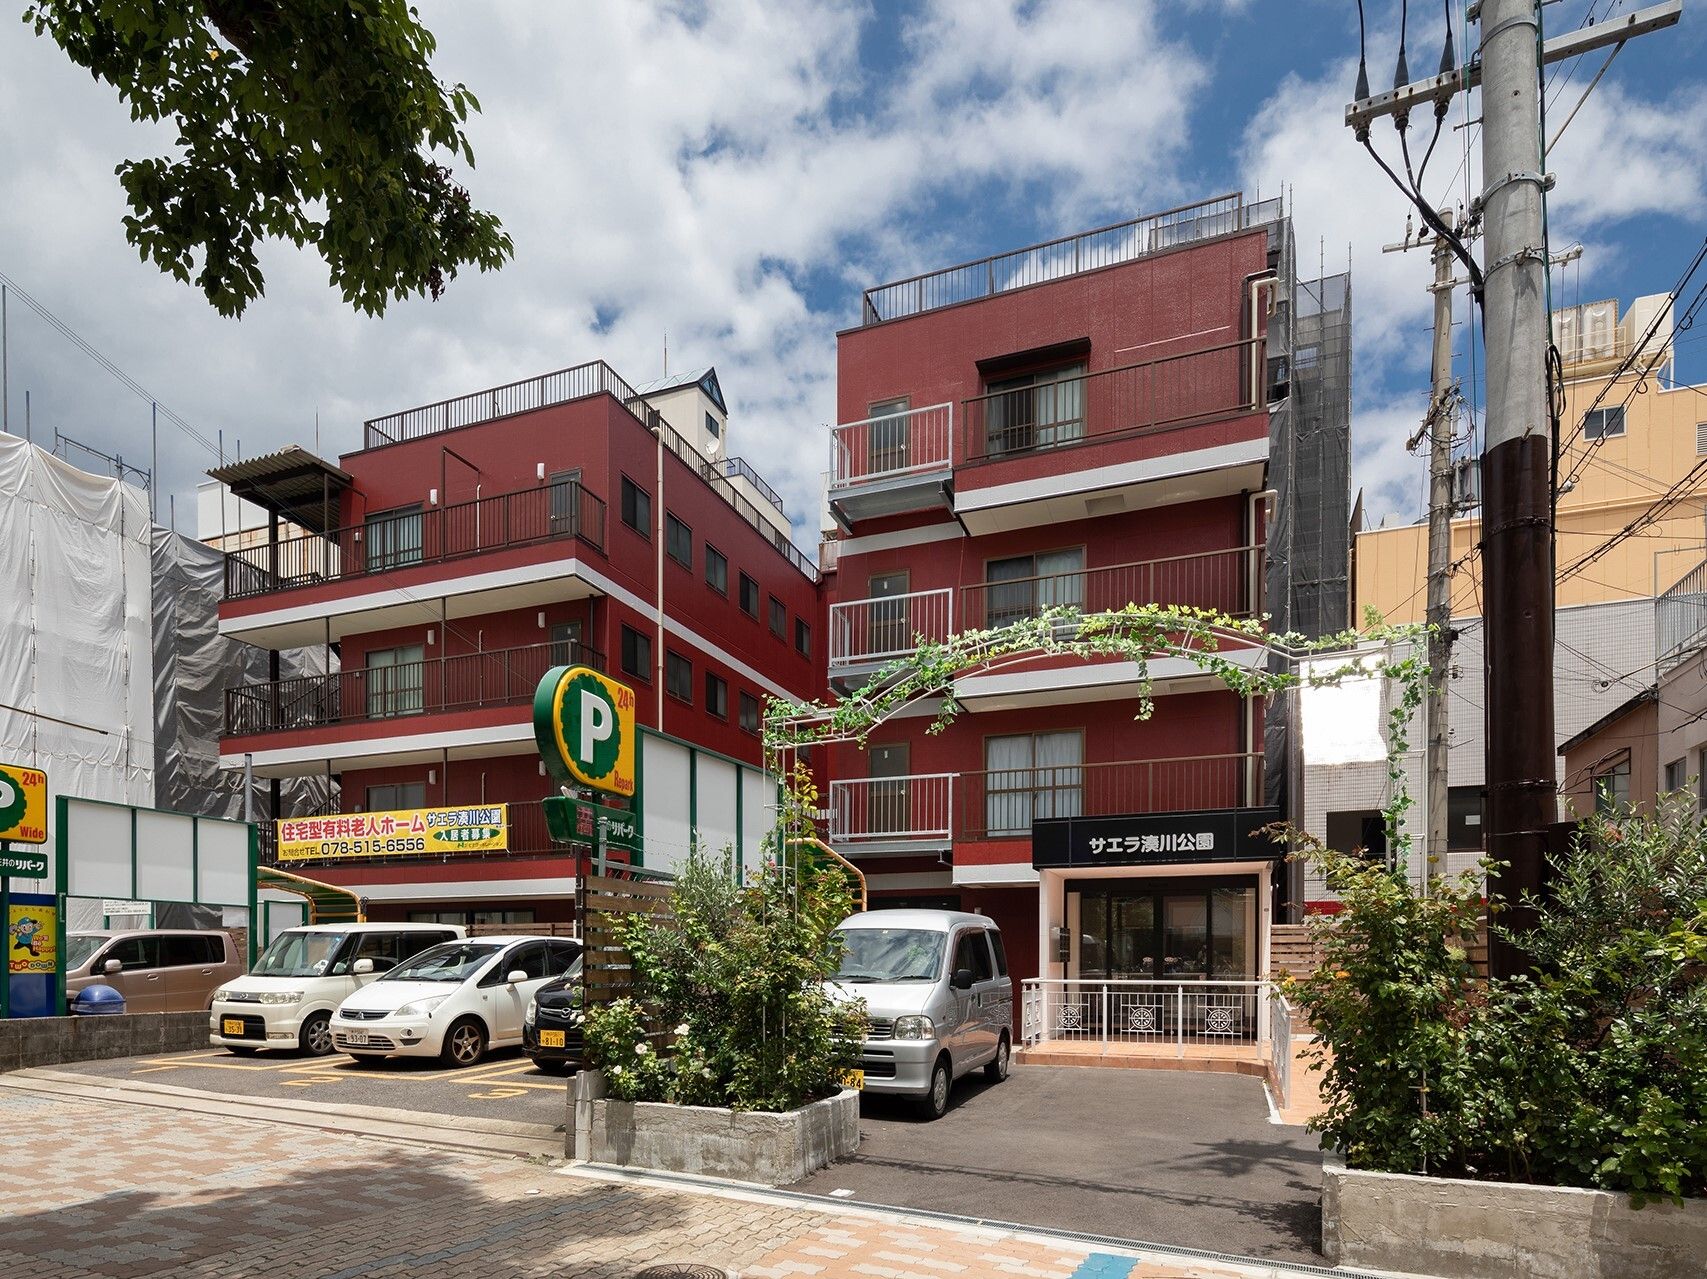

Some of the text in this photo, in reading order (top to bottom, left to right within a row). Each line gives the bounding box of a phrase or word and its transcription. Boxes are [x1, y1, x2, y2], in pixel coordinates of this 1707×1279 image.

[617, 687, 634, 711] 24h
[580, 689, 613, 764] P
[22, 771, 44, 787] 24h
[614, 770, 633, 791] Repark
[427, 808, 501, 827] サエラ湊川公園
[20, 825, 44, 839] Wide
[281, 814, 426, 842] 住宅型有料老人ホーム
[439, 828, 491, 842] 入居者募集
[321, 838, 425, 855] 078-515-6556
[1088, 832, 1215, 854] サエラ湊川公園
[9, 960, 29, 971] TWO
